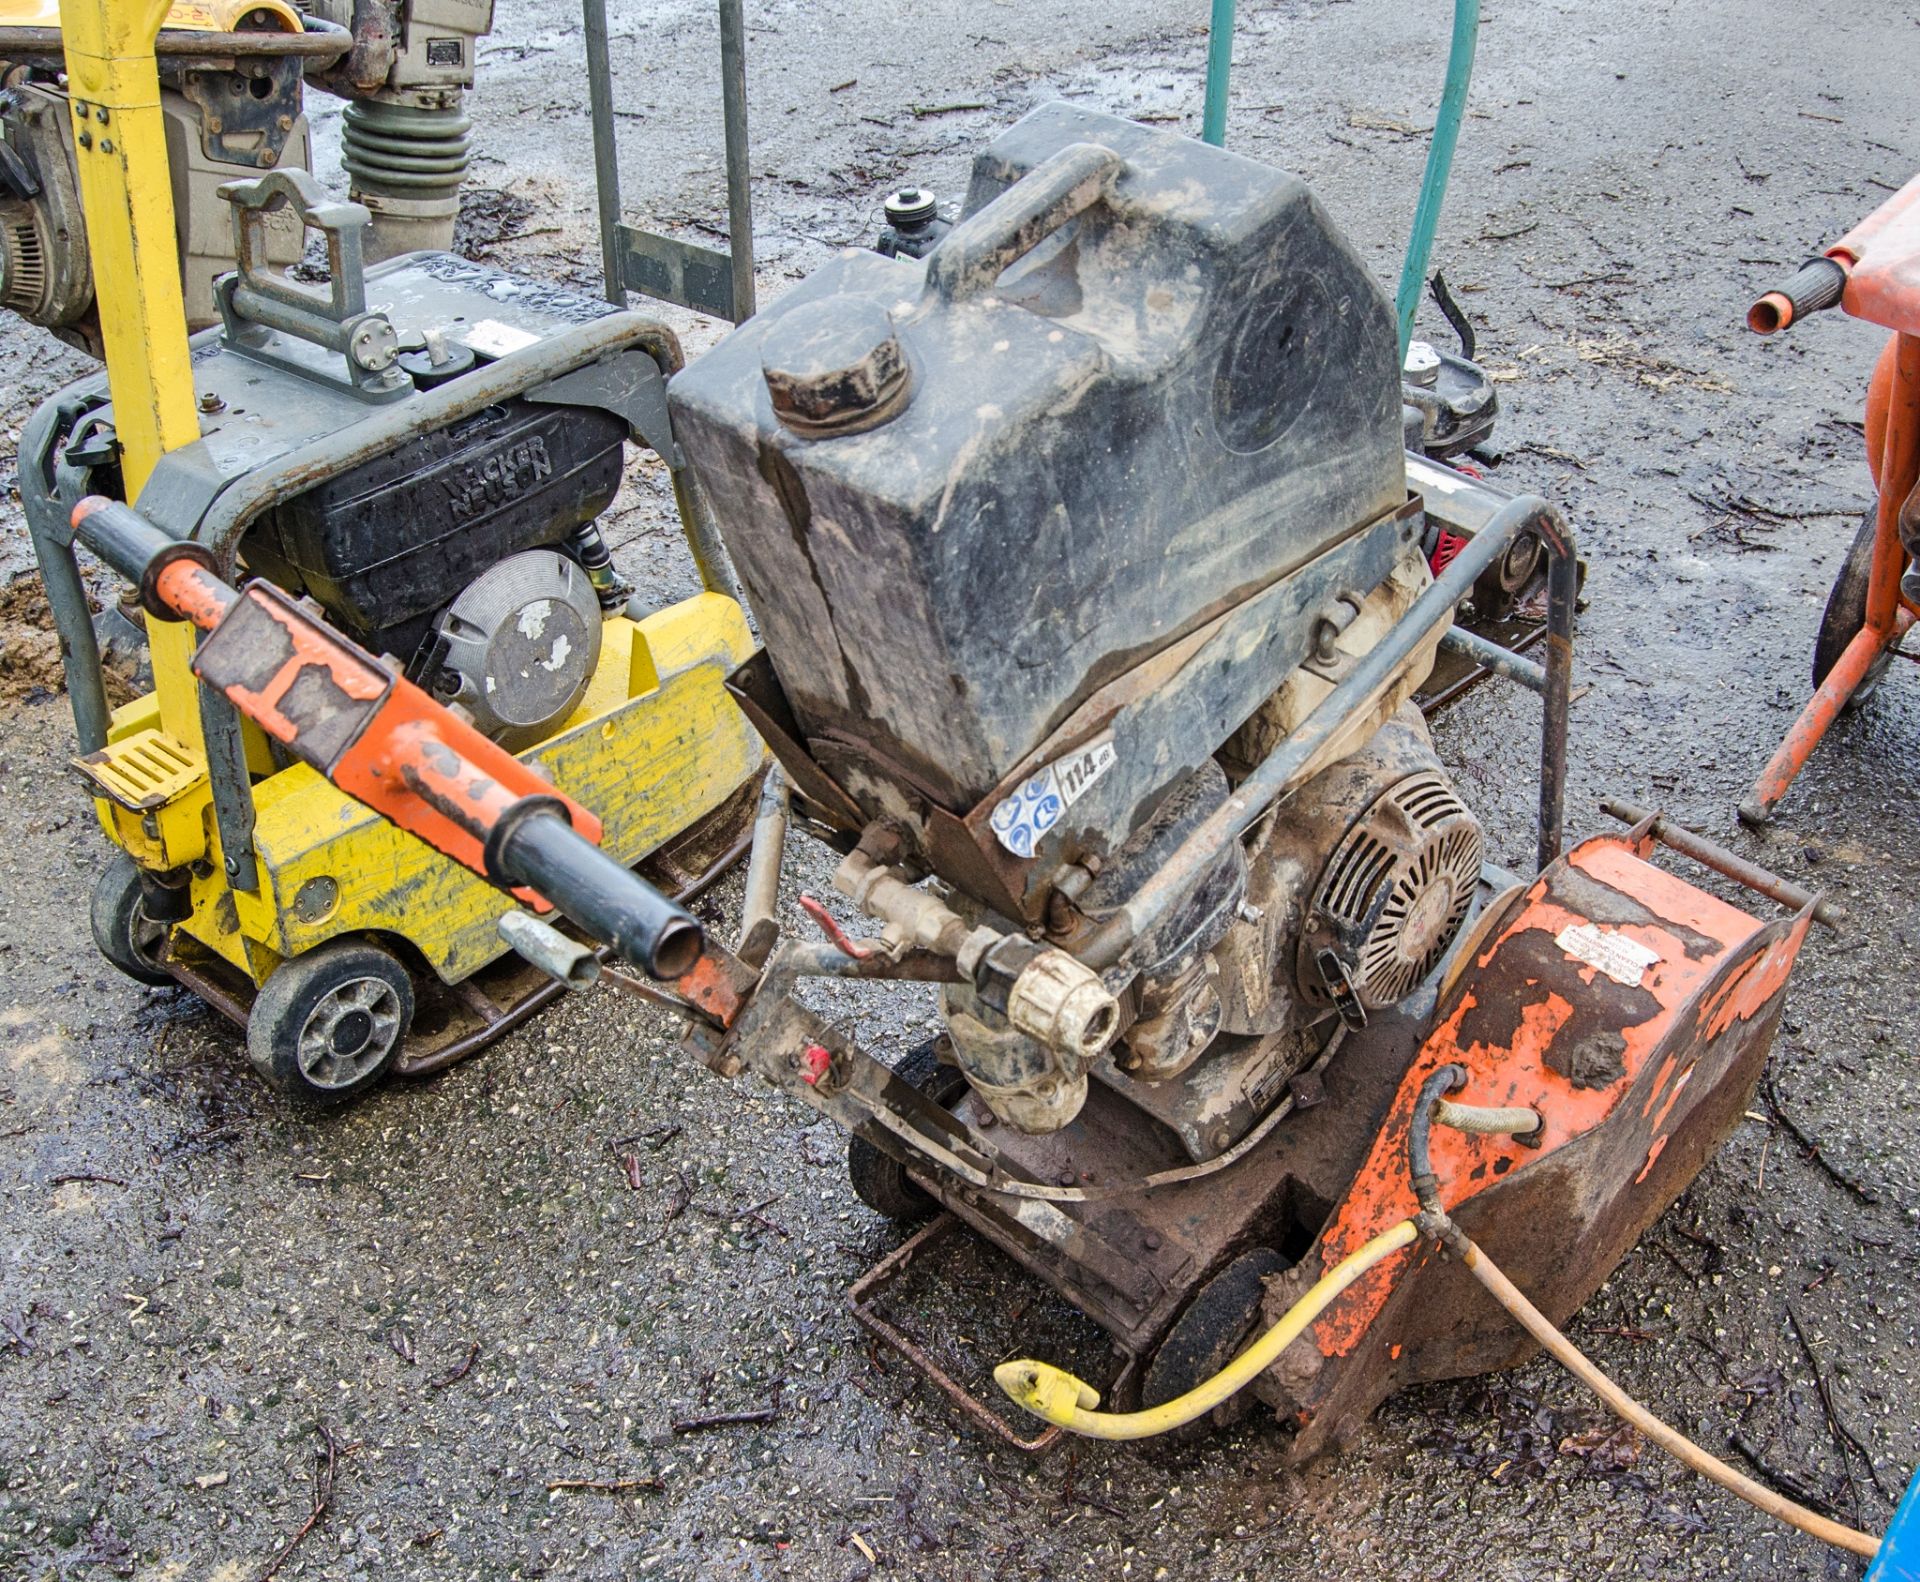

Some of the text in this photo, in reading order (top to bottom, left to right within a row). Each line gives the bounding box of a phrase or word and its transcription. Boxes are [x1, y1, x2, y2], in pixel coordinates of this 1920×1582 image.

[440, 435, 548, 498] WACKER
[448, 452, 552, 519] NEUSON
[1066, 752, 1096, 793] 114
[1615, 951, 1639, 969] CLEAN
